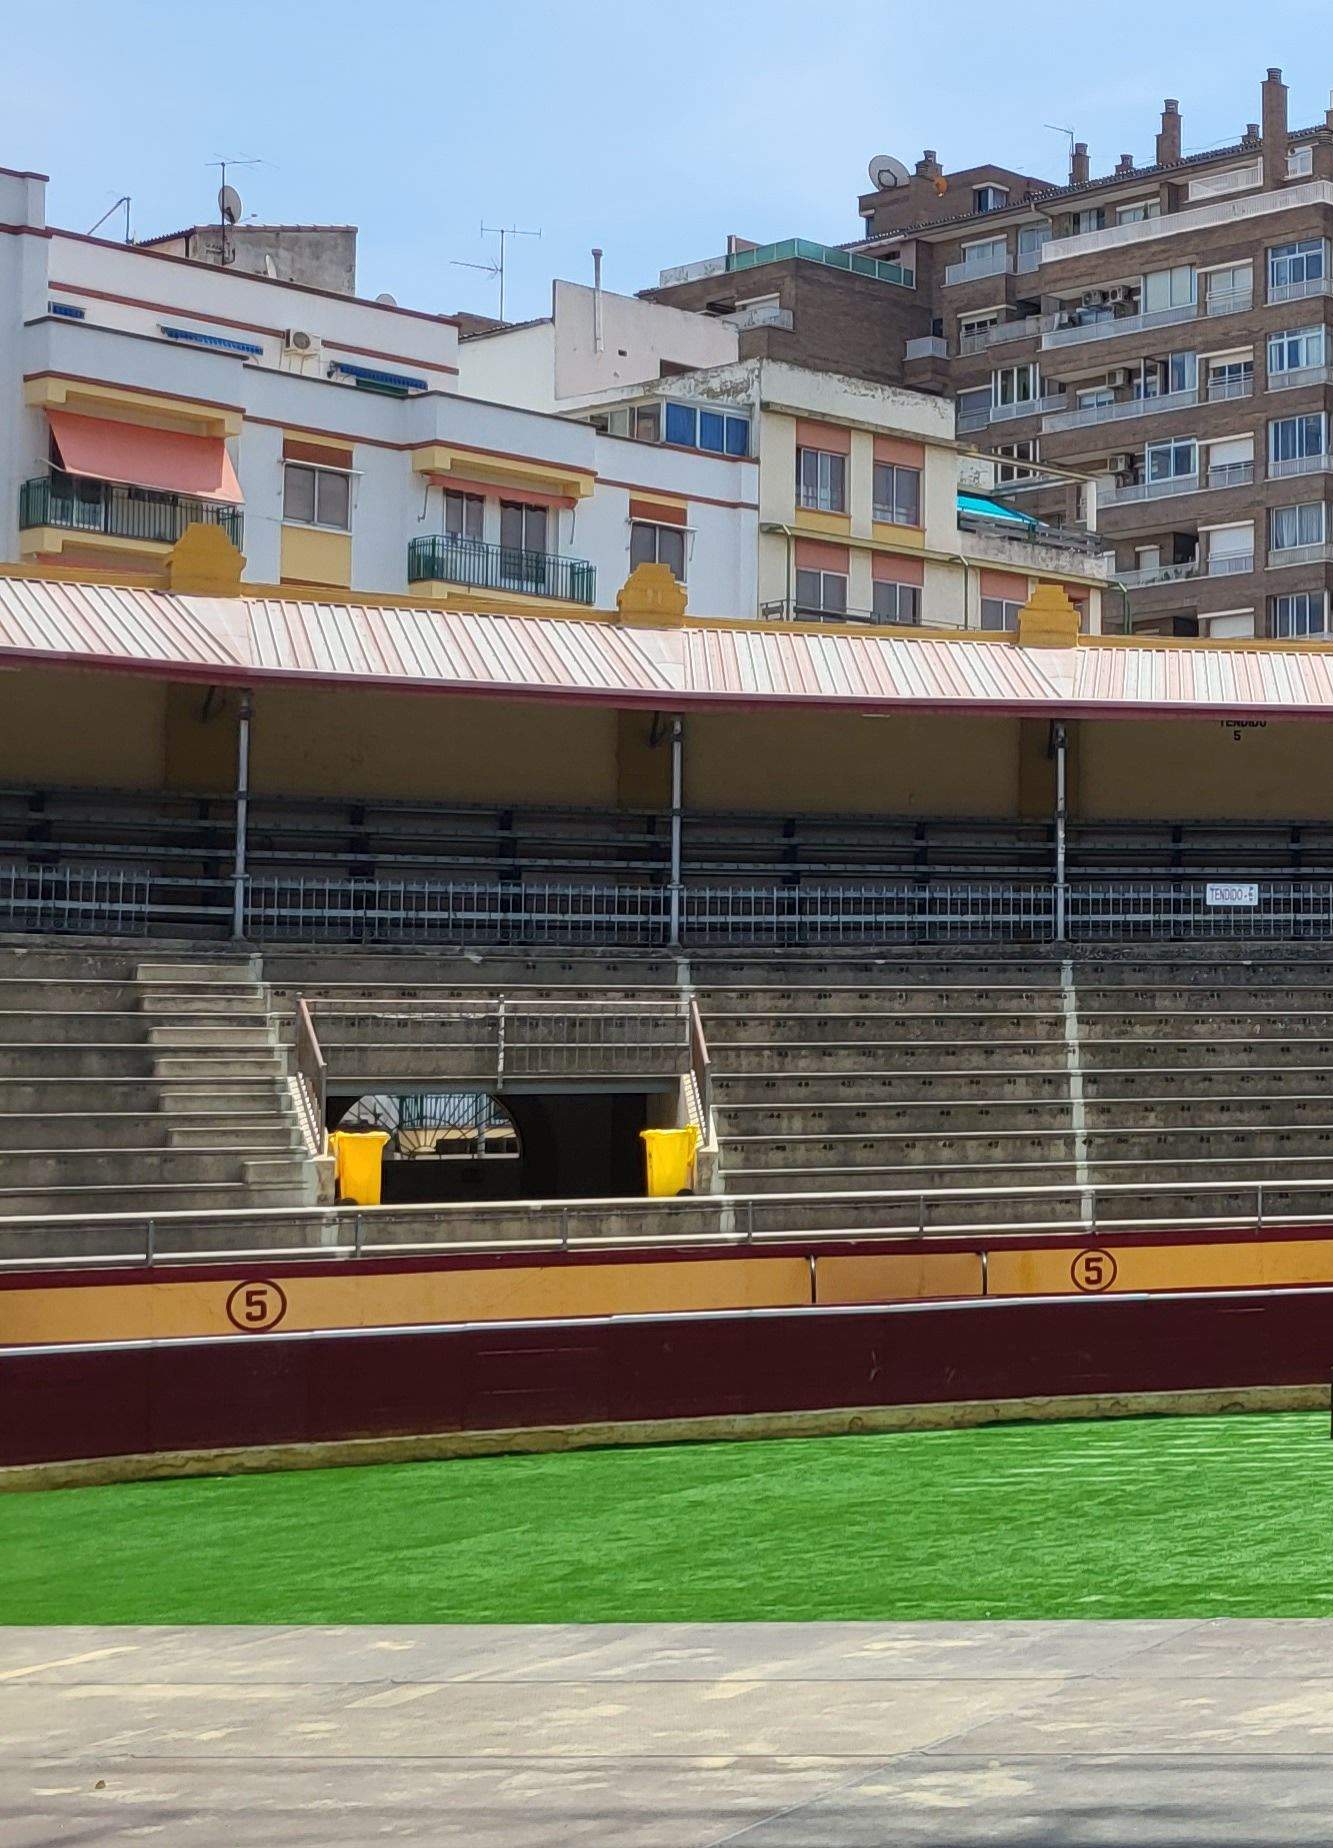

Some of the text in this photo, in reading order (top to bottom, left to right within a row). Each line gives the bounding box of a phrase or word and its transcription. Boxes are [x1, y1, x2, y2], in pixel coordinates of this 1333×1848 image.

[1233, 729, 1241, 741] 5
[1084, 1256, 1103, 1285] 5
[245, 1289, 268, 1322] 5
